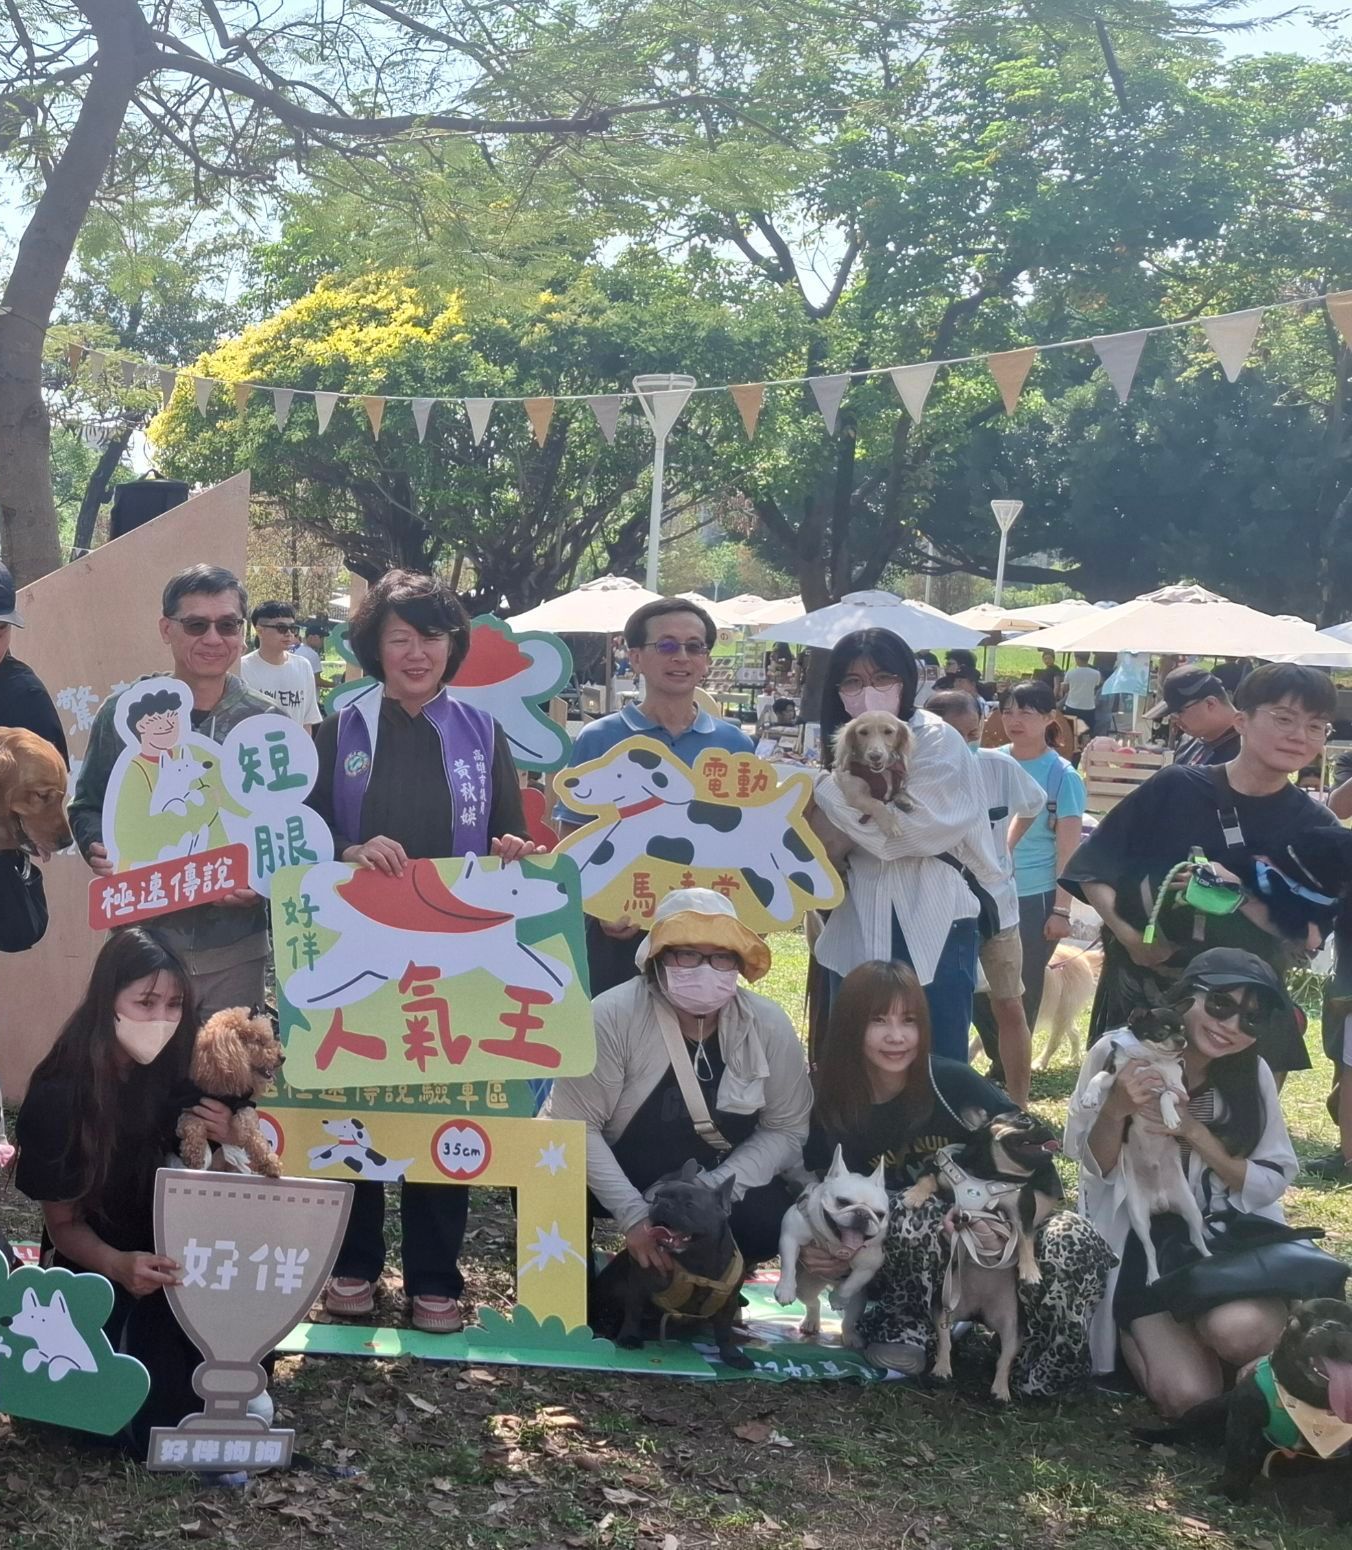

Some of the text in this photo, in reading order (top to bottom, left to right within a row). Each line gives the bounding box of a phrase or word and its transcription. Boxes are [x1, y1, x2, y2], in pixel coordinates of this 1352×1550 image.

[702, 756, 769, 798] 電動
[101, 856, 235, 919] 極速傳說
[280, 894, 321, 971] 好伴
[314, 959, 562, 1073] 人氣王
[442, 1142, 481, 1158] 35cm
[182, 1237, 311, 1295] 好伴
